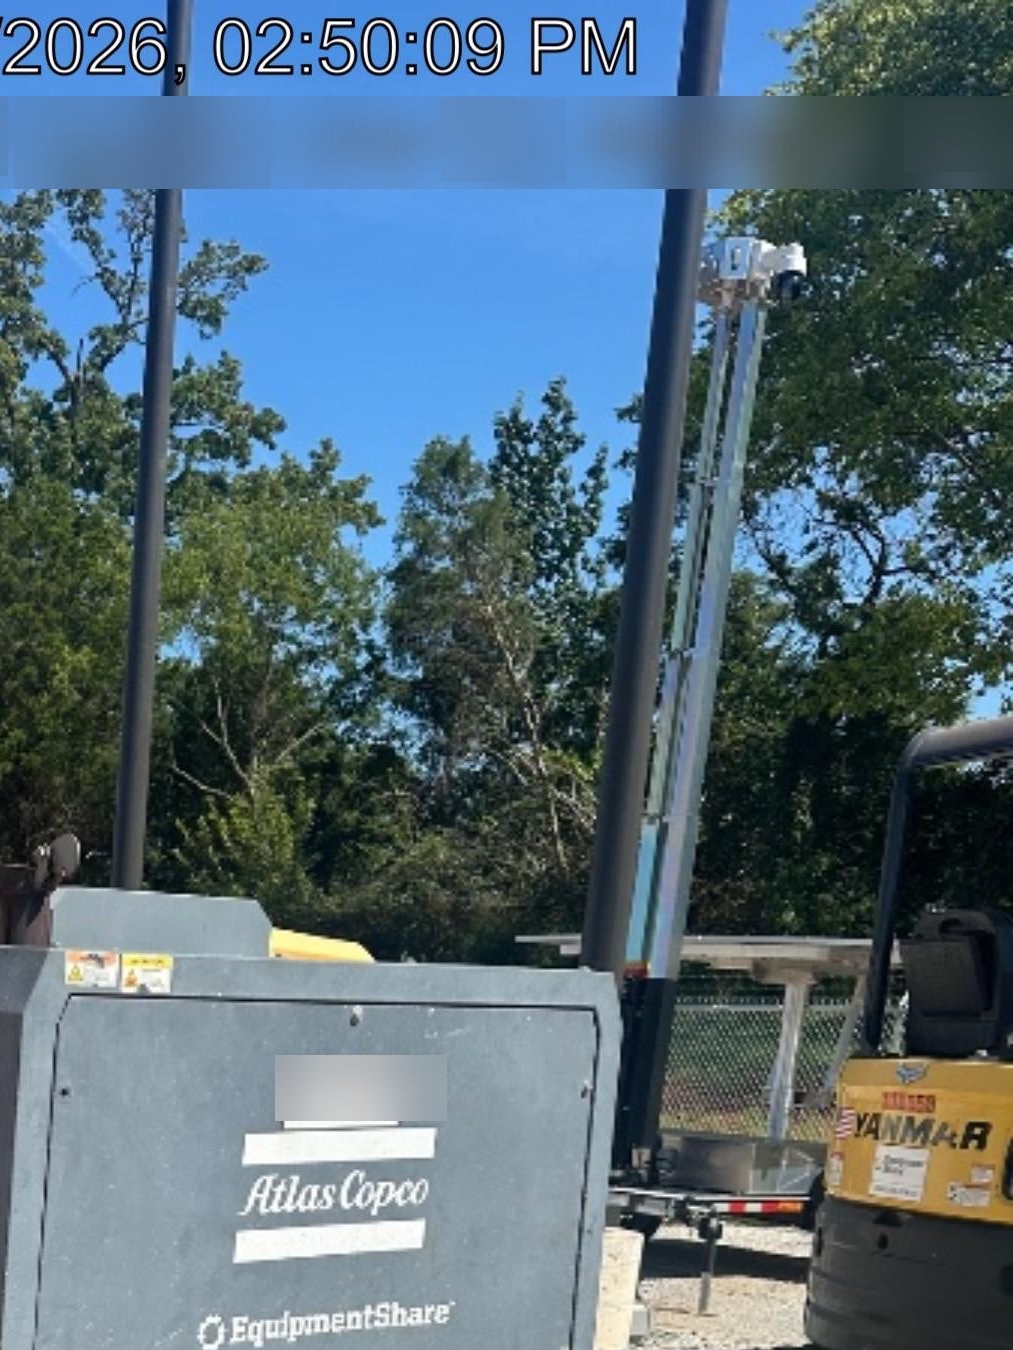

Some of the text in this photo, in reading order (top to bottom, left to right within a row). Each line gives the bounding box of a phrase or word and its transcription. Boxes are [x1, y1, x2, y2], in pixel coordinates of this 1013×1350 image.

[854, 1112, 993, 1151] YANMAR
[237, 1168, 430, 1217] Atlas Copco
[229, 1300, 452, 1348] EquipmentShare
